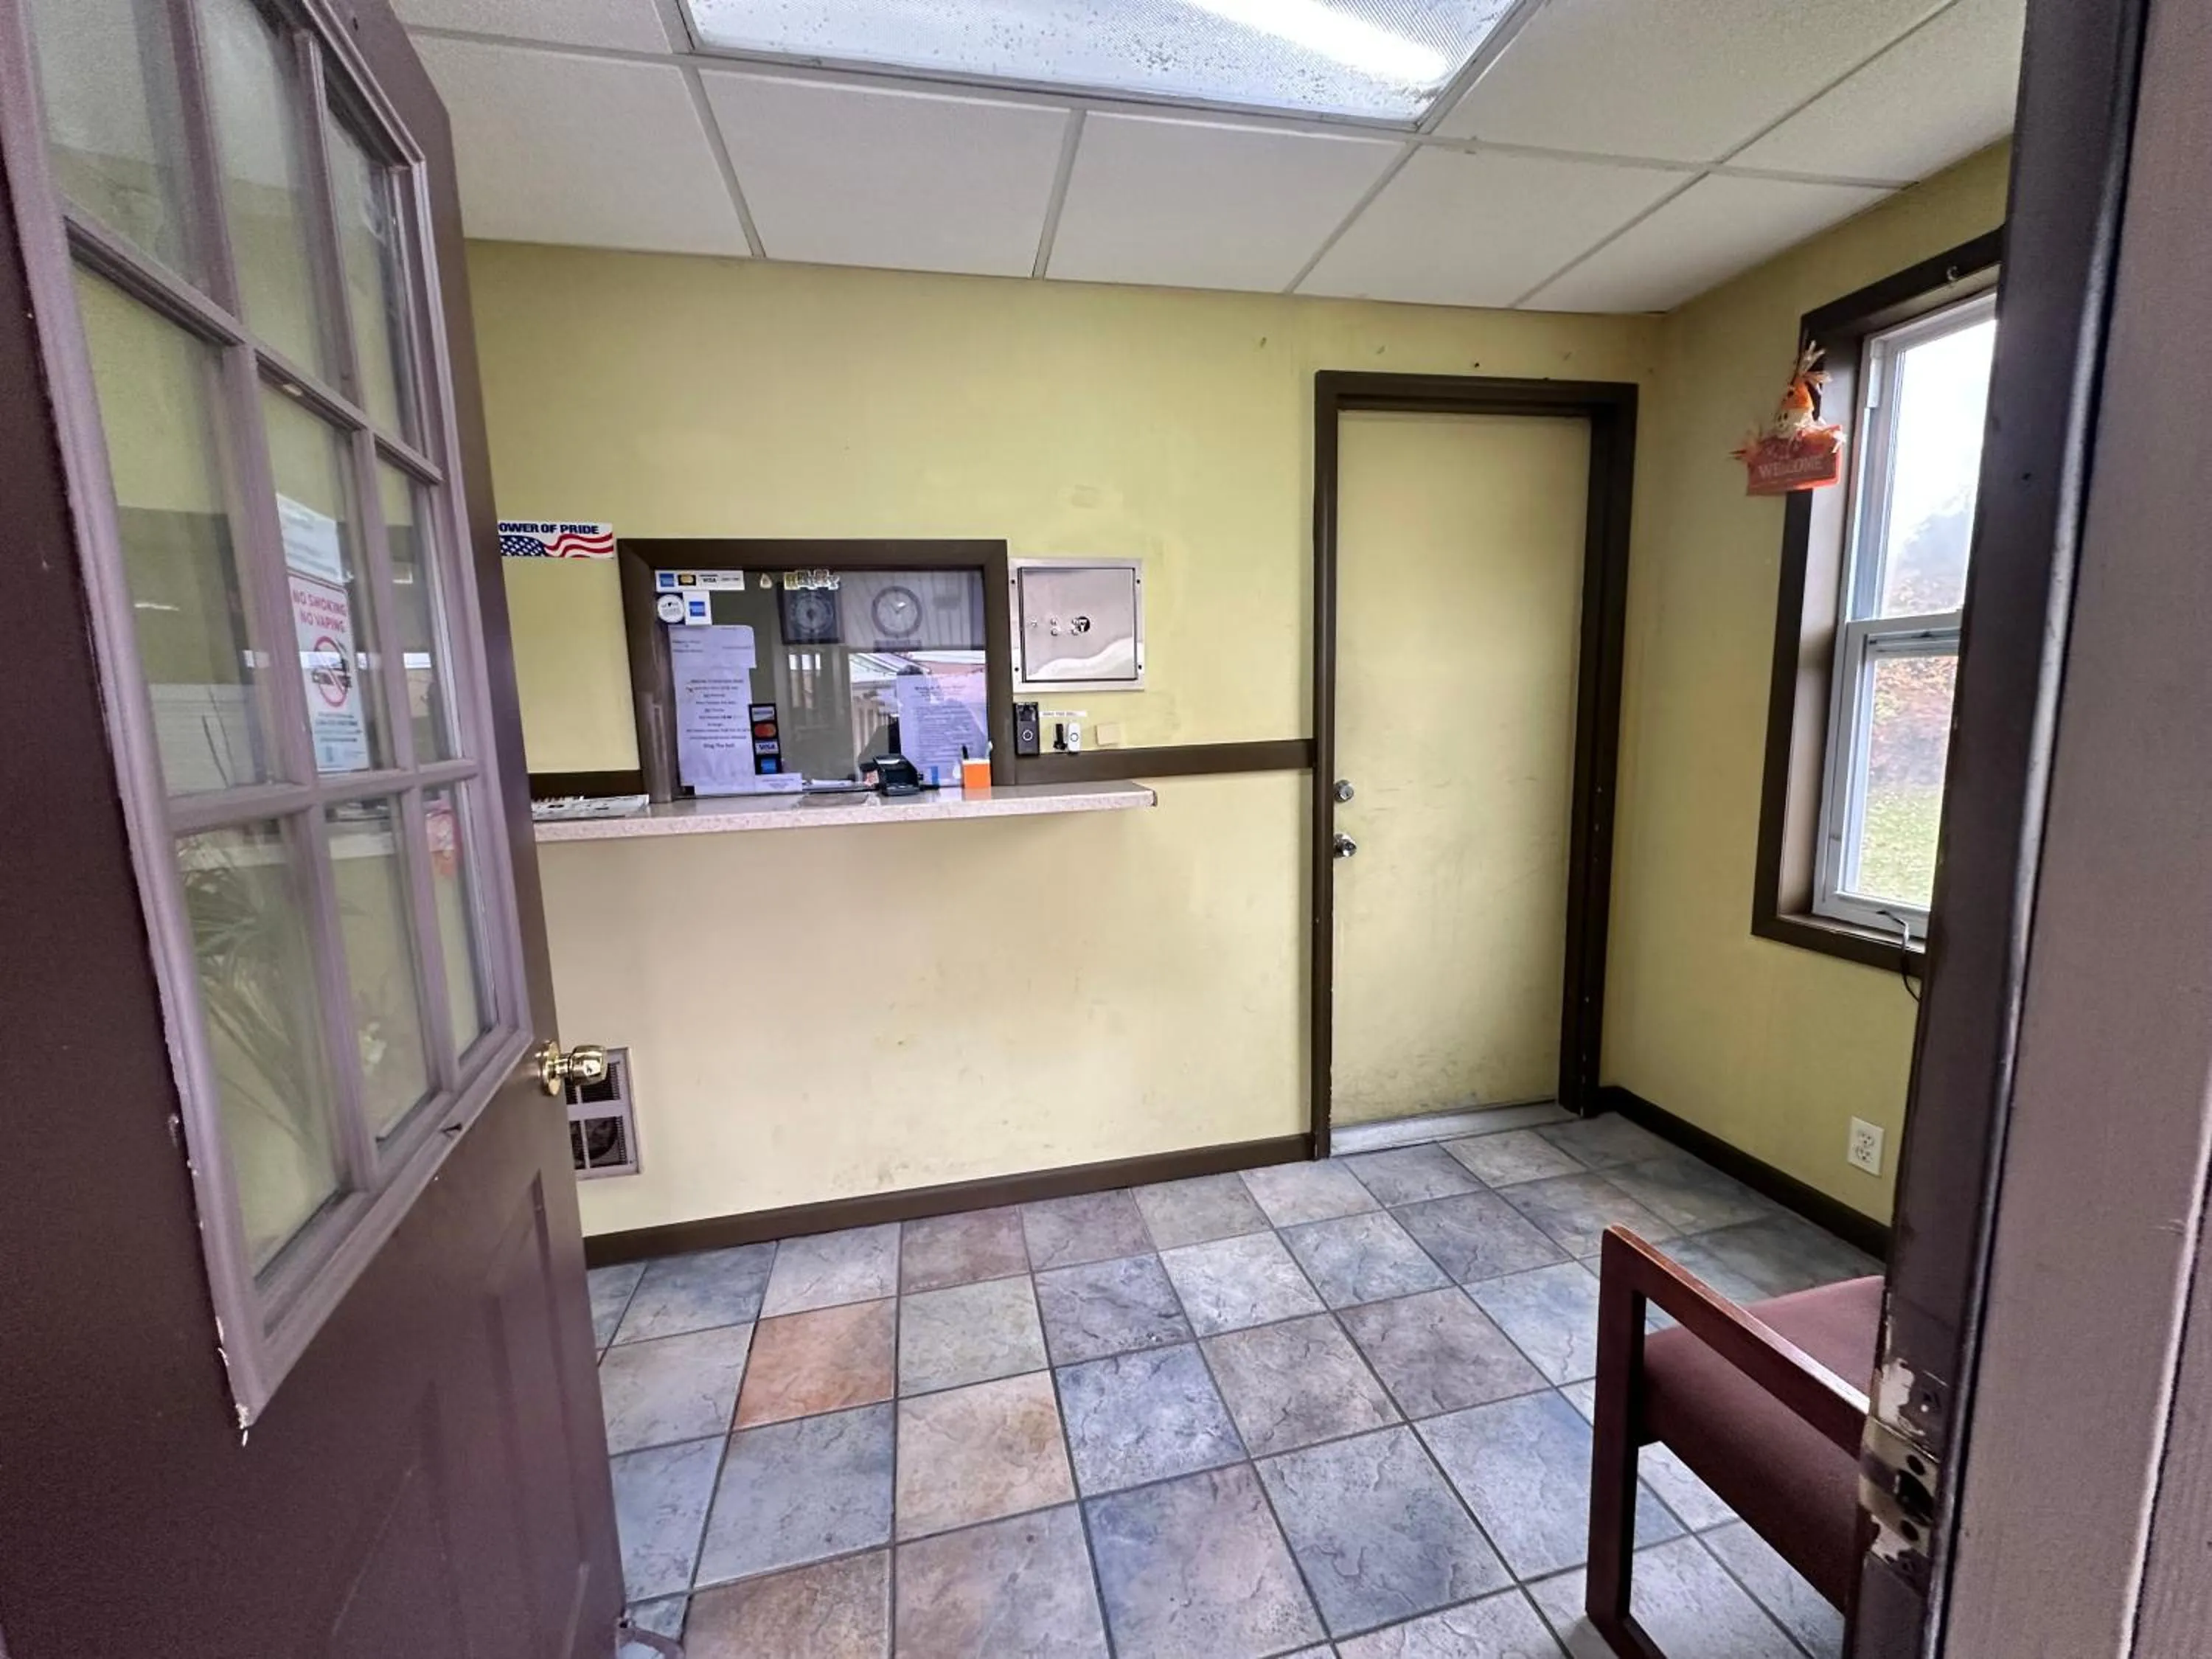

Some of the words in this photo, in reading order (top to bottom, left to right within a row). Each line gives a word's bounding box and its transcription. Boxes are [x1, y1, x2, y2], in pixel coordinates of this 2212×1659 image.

[1758, 454, 1824, 479] WELCOME
[540, 524, 557, 533] OF
[560, 524, 599, 534] PRIDE
[293, 590, 307, 605] NO
[307, 593, 347, 616] SMOKING
[300, 608, 313, 625] NO
[313, 612, 344, 633] VAPING
